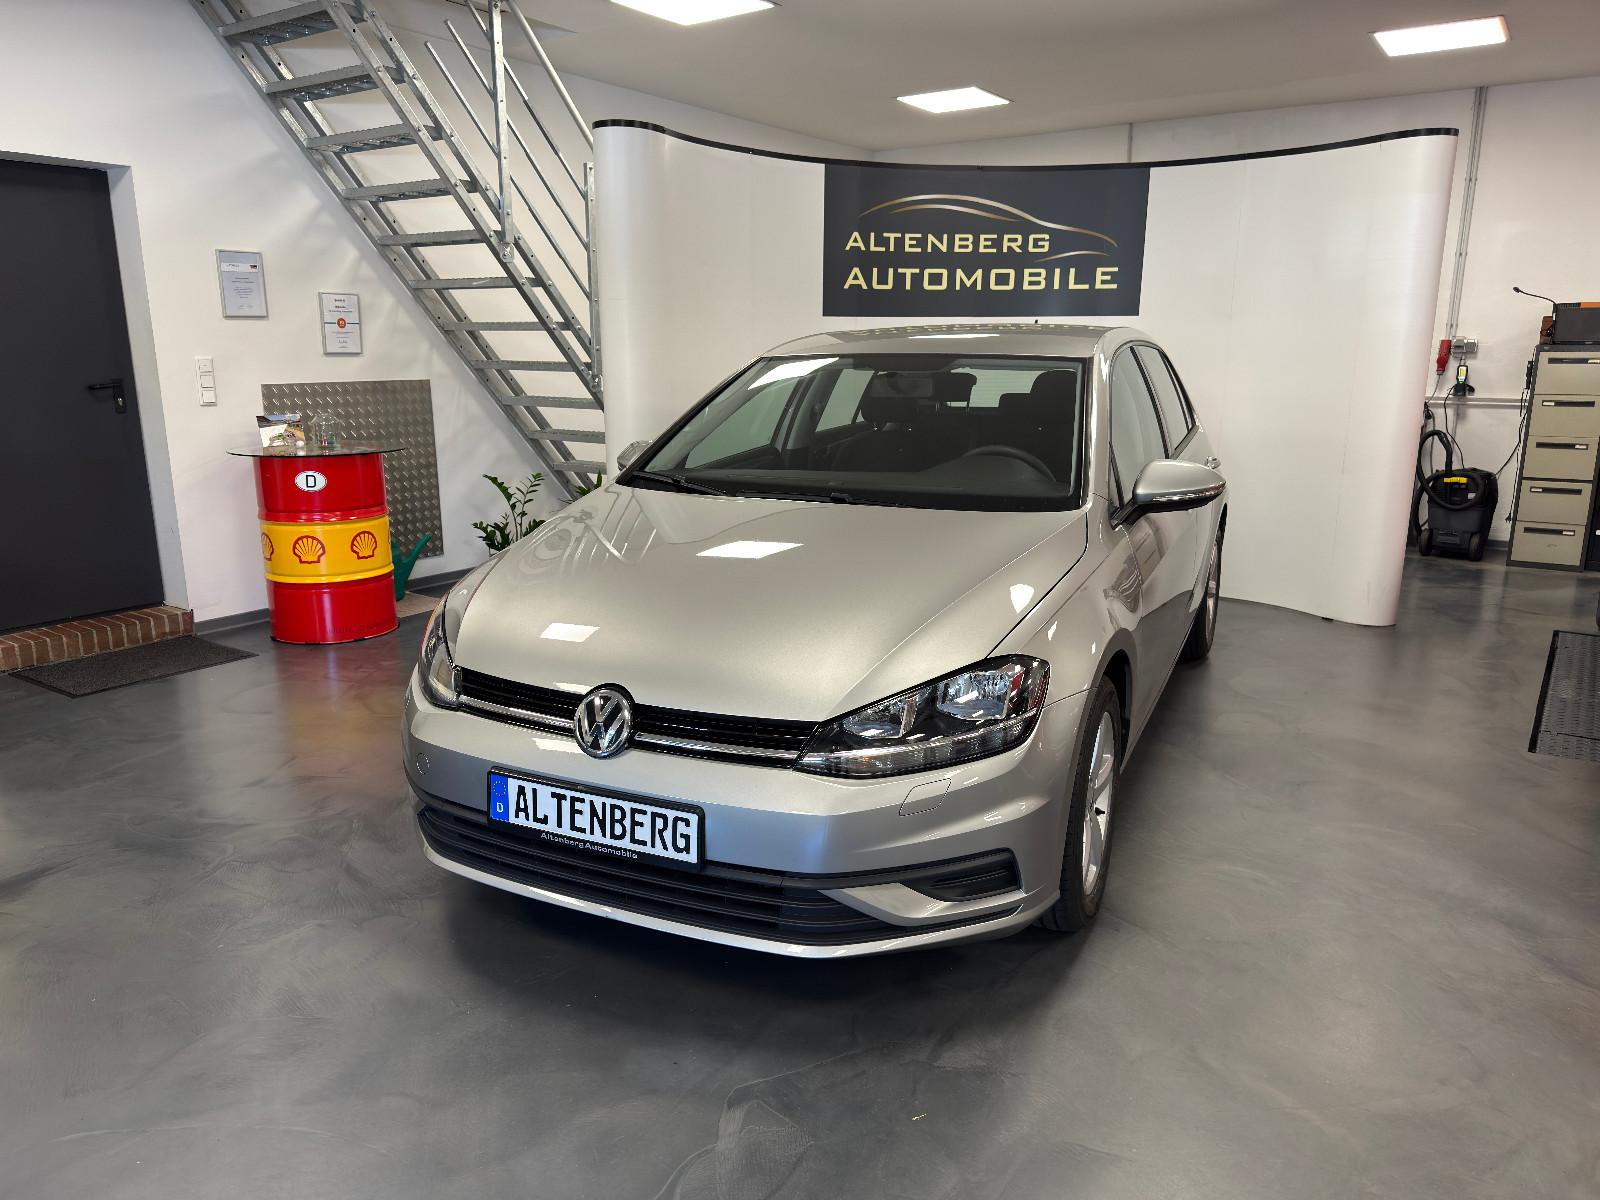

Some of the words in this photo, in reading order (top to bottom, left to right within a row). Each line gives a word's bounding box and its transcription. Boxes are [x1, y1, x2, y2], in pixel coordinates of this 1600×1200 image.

[845, 231, 1051, 253] ALTENBERG
[843, 266, 1119, 291] AUTOMOBILE
[305, 474, 316, 487] D
[577, 689, 626, 752] VW
[496, 802, 504, 813] D
[514, 784, 691, 854] ALTENBERG
[540, 832, 584, 849] Altenberg
[584, 842, 638, 859] Automobile
